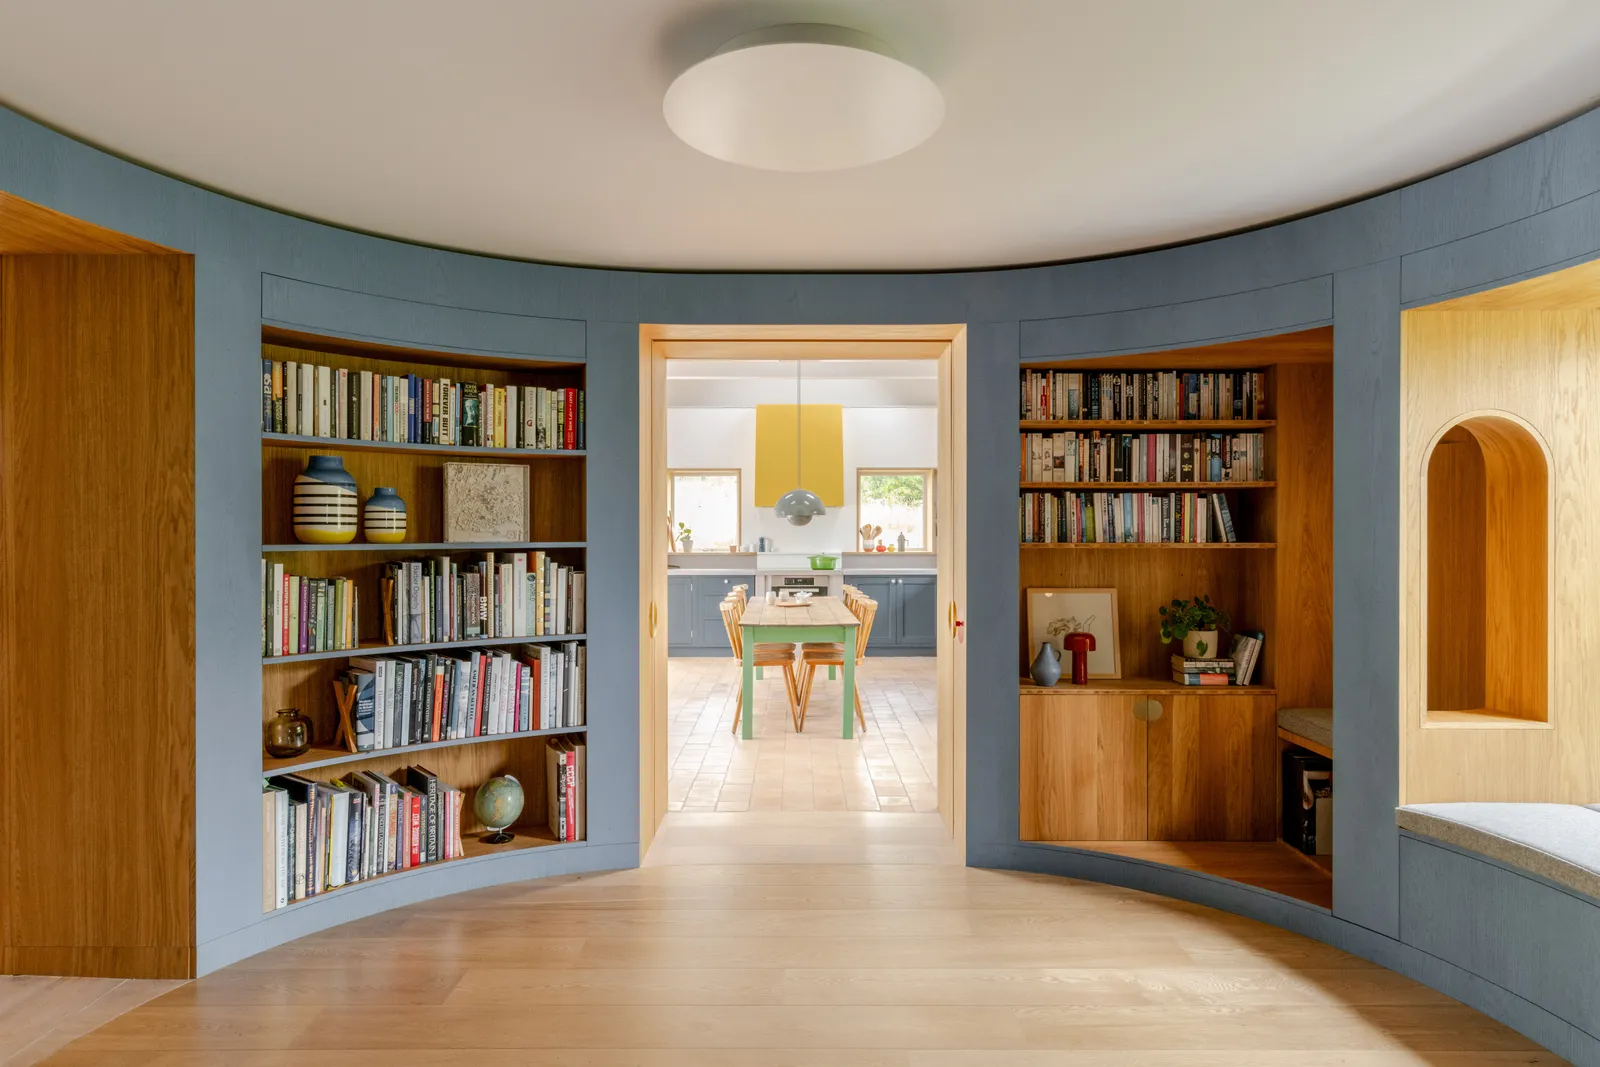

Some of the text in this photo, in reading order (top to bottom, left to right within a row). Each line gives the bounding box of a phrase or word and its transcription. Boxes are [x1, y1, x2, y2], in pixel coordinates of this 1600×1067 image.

[412, 586, 420, 610] Osgerby
[521, 669, 530, 695] CITY
[566, 765, 575, 787] CCCP
[412, 813, 420, 826] WELT
[429, 814, 436, 825] OF
